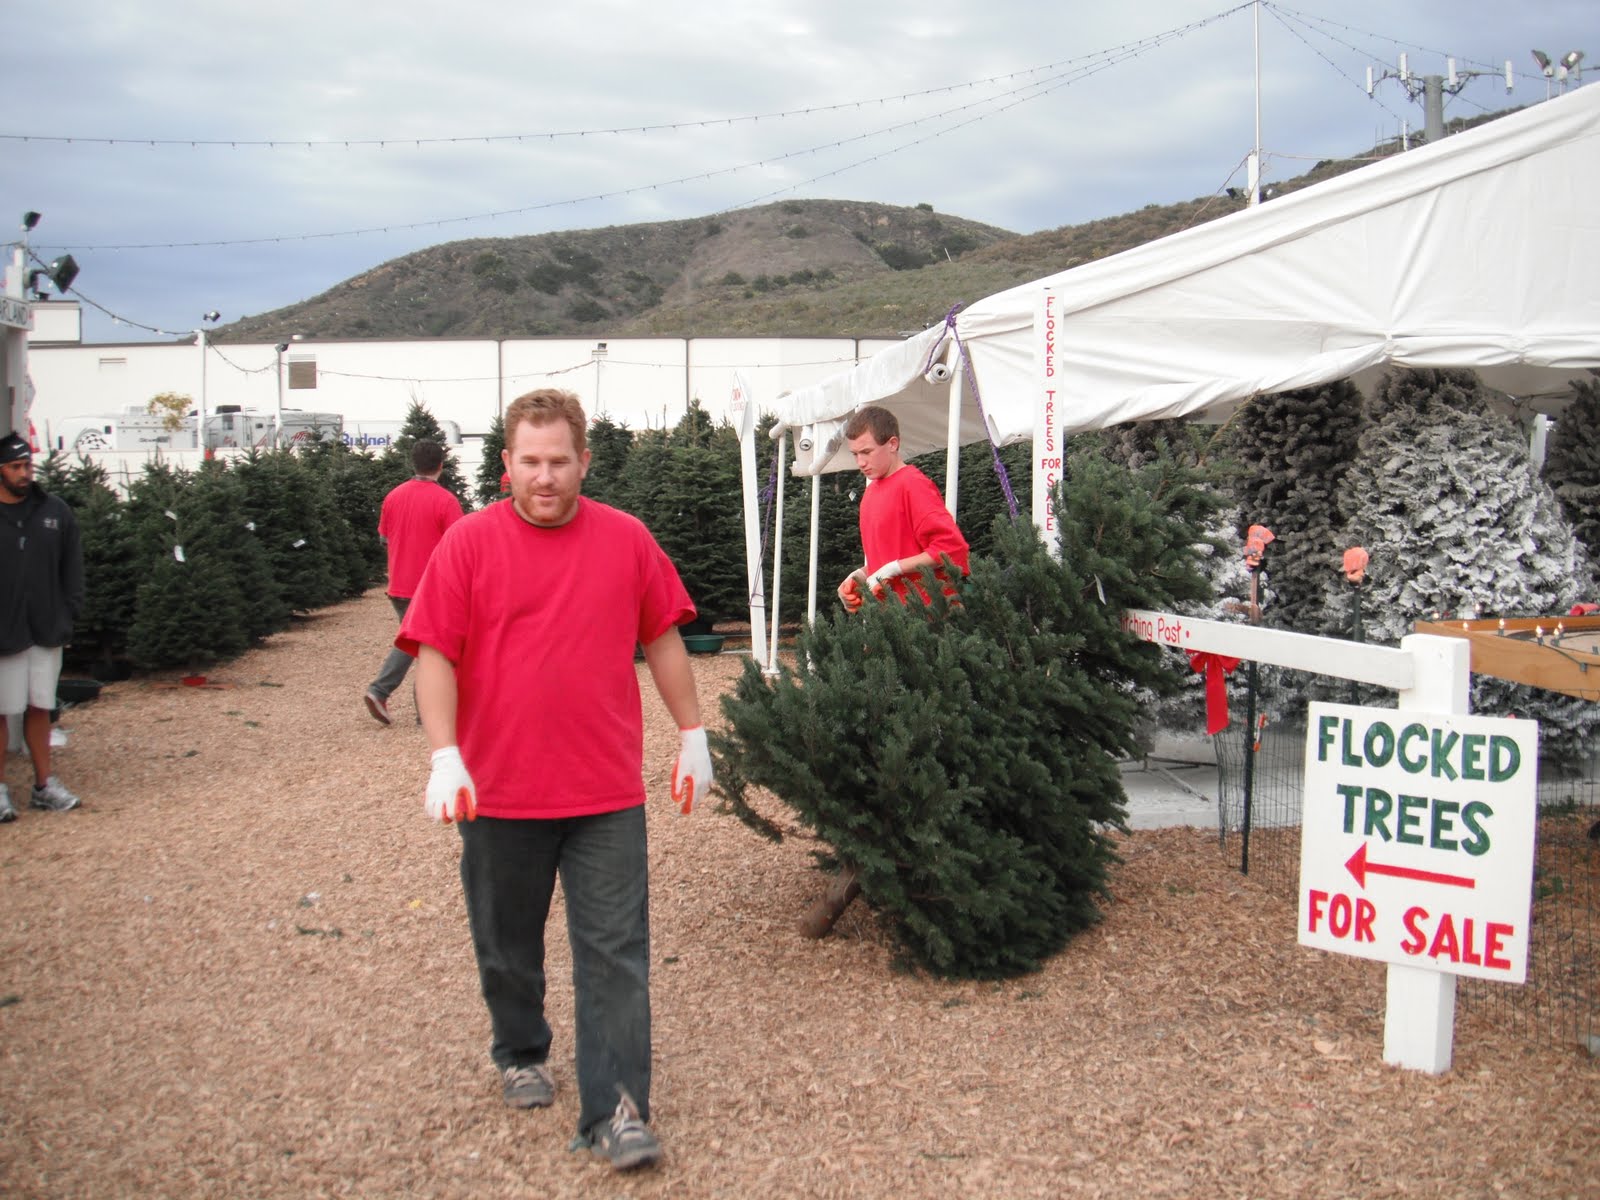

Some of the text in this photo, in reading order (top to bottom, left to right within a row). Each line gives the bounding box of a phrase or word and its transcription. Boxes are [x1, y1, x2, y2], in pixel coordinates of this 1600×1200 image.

[1046, 296, 1056, 377] FLOCKED
[1045, 390, 1056, 452] TREES
[1041, 458, 1061, 470] FOR
[1157, 617, 1182, 644] Post
[1318, 715, 1521, 783] FLOCKED
[1336, 783, 1494, 856] TREES
[1308, 889, 1514, 970] FOR SALE
